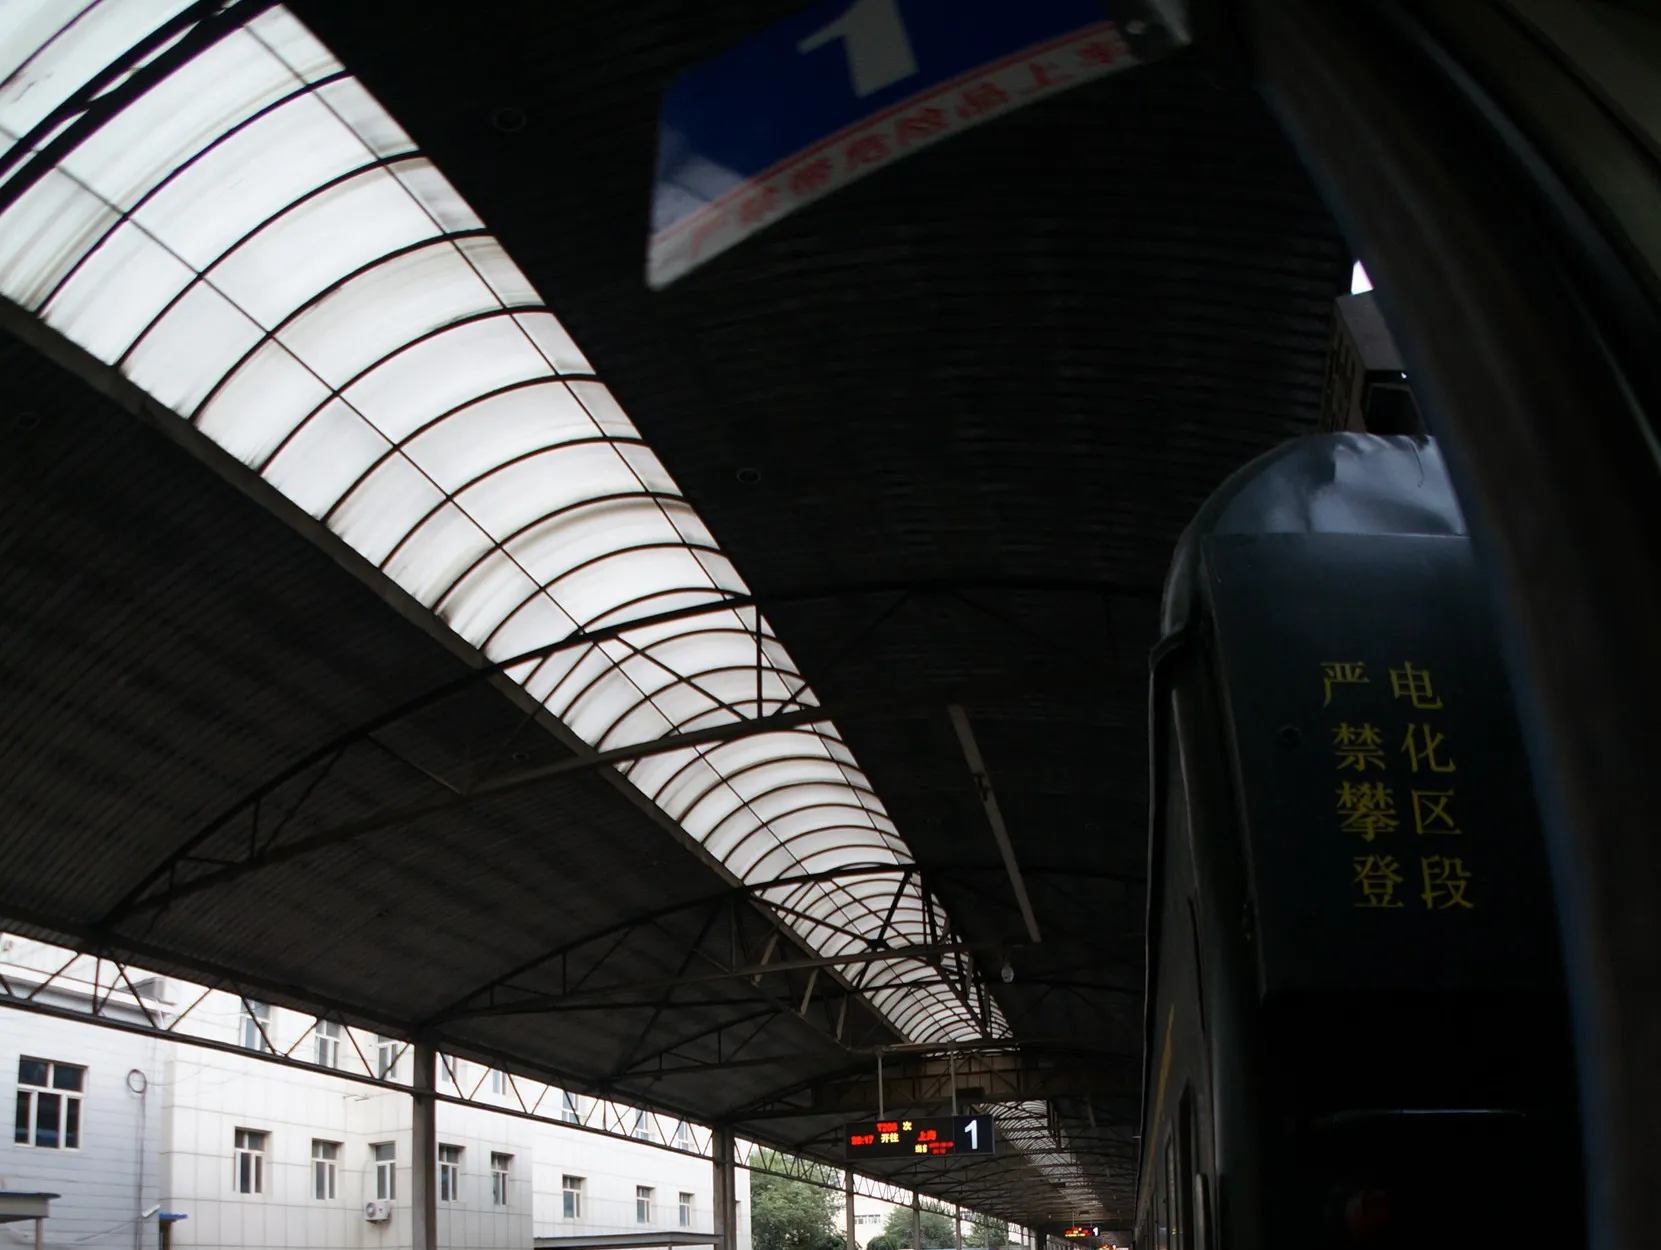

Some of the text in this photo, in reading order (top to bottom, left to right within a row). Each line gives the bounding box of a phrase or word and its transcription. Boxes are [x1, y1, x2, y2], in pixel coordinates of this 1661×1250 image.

[797, 0, 919, 98] 1
[1320, 661, 1405, 909] 严禁攀登
[1388, 660, 1476, 911] 电化区段
[881, 1132, 899, 1143] 开往
[964, 1119, 978, 1150] 1
